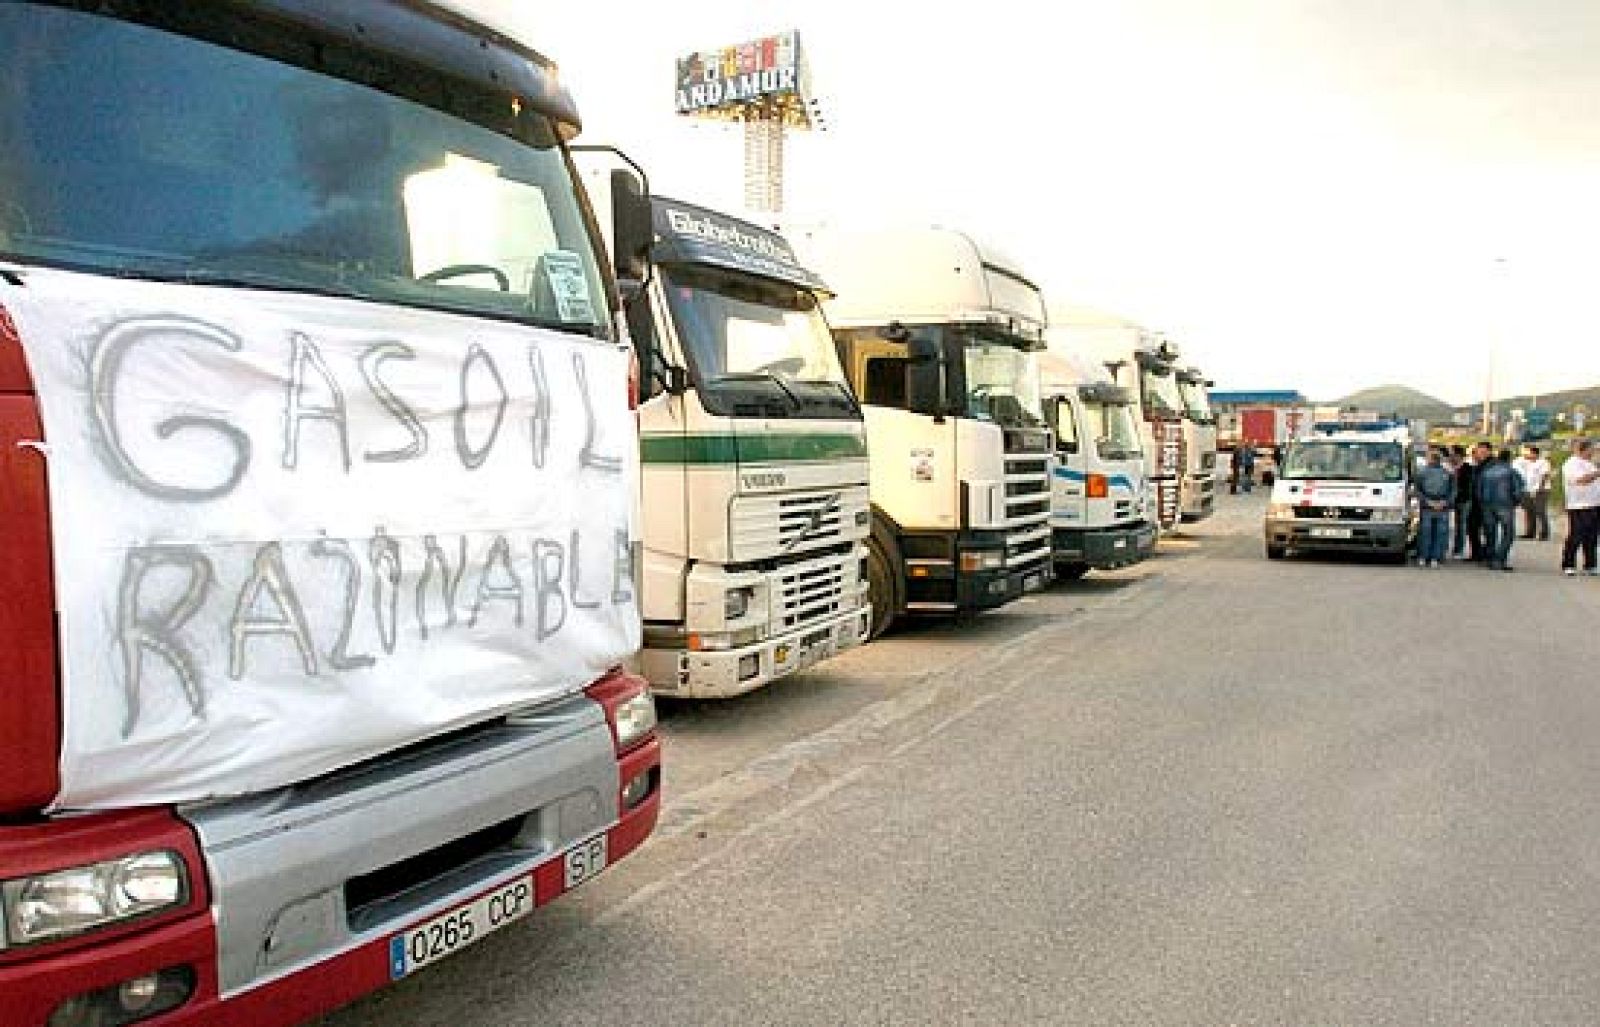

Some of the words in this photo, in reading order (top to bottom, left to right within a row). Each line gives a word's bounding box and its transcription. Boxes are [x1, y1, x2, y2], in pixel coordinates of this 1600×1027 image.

[675, 68, 795, 109] ANDAMUR
[86, 312, 623, 504] GASOIL
[114, 525, 634, 738] RAZONABLE
[412, 909, 475, 964] 0265
